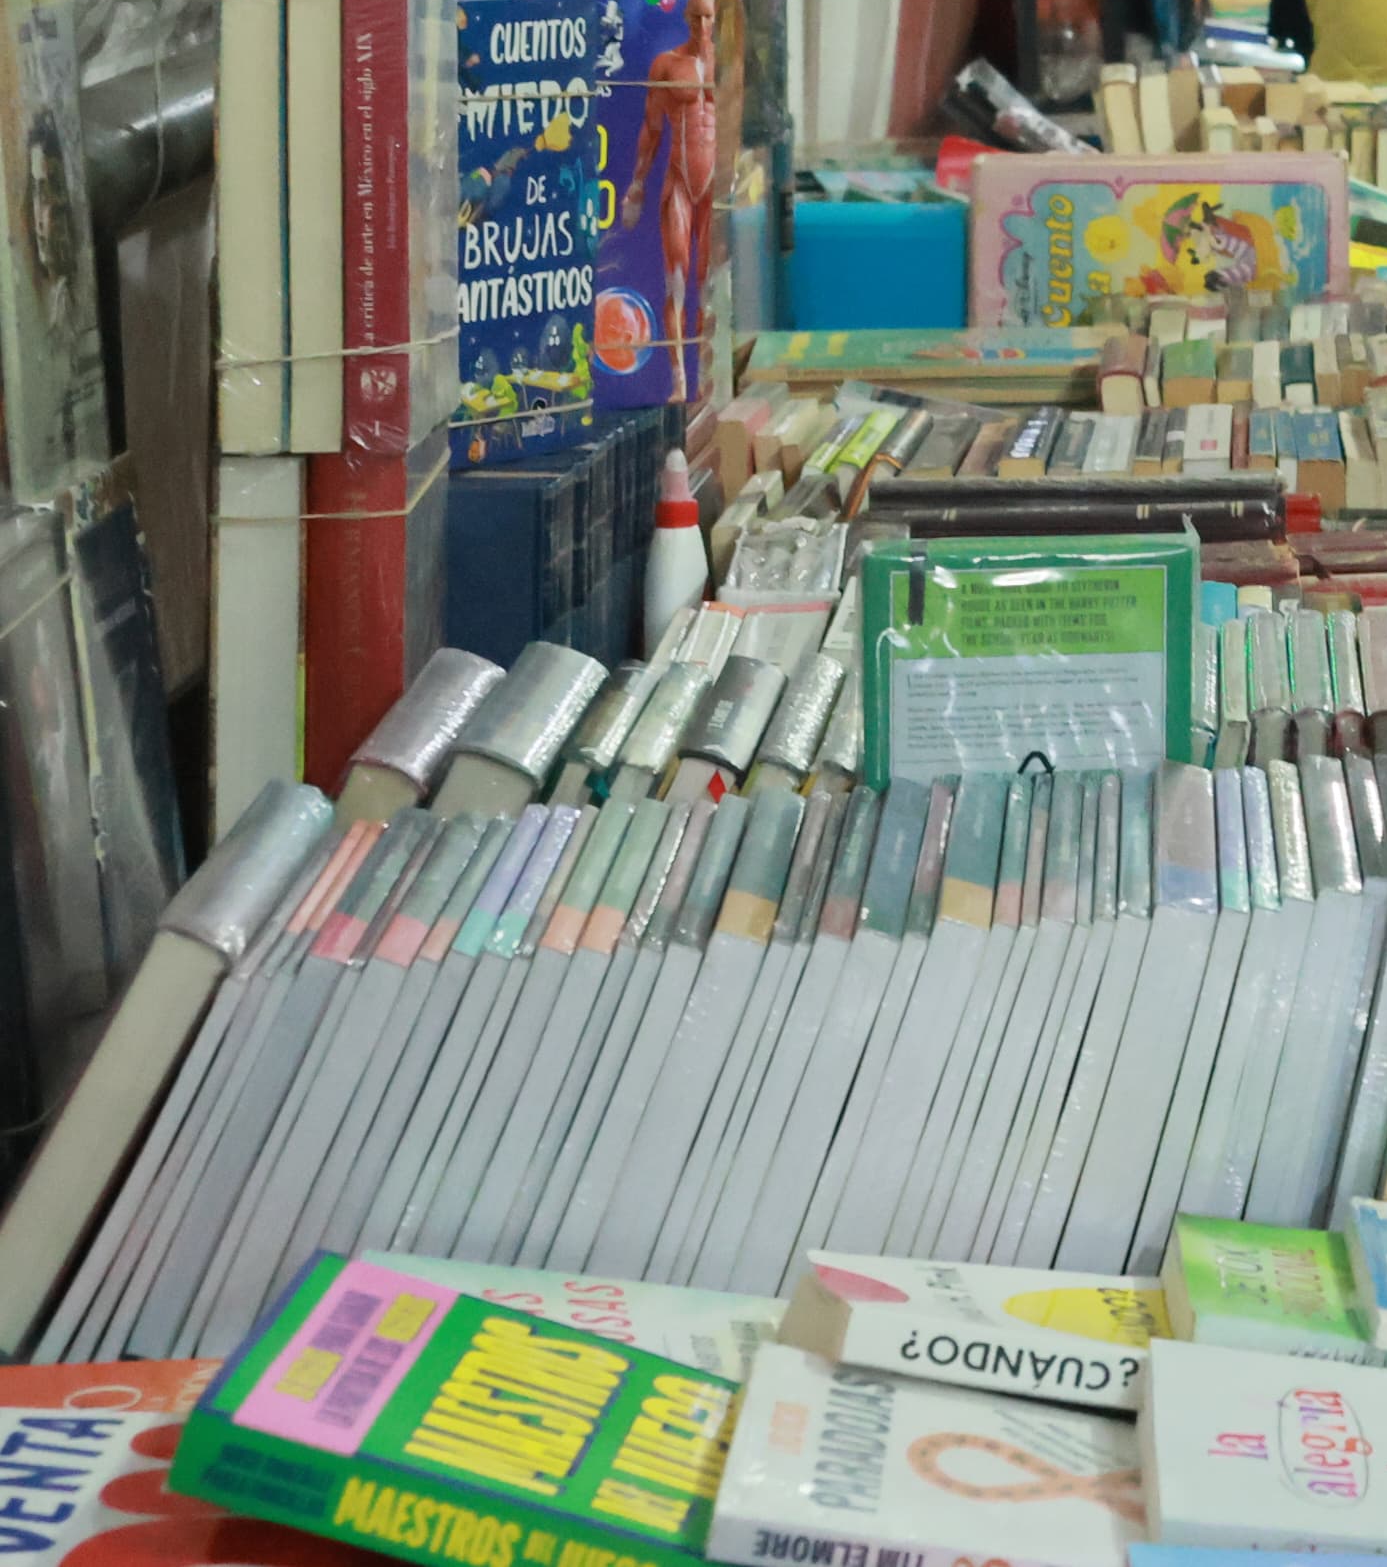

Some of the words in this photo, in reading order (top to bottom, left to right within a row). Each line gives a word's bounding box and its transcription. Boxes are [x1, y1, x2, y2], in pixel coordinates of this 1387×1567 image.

[357, 32, 375, 64] XIX
[489, 17, 588, 66] CUENTOS
[357, 67, 376, 102] siglo
[357, 105, 375, 119] el
[464, 76, 591, 141] MIEDO
[357, 122, 375, 141] en
[357, 145, 375, 197] México
[525, 174, 547, 206] DE
[357, 224, 375, 254] arte
[463, 210, 575, 271] BRUJAS
[357, 259, 375, 276] de
[457, 264, 594, 326] ANTÁSTICOS
[900, 1328, 1141, 1393] ¿CUÁNDO?
[405, 1316, 630, 1497] MAESTROS
[1207, 1431, 1269, 1461] la
[0, 1414, 125, 1555] VENTA
[332, 1474, 522, 1567] MAESTROS
[751, 1529, 870, 1567] ELMORE
[874, 1547, 925, 1567] TIM
